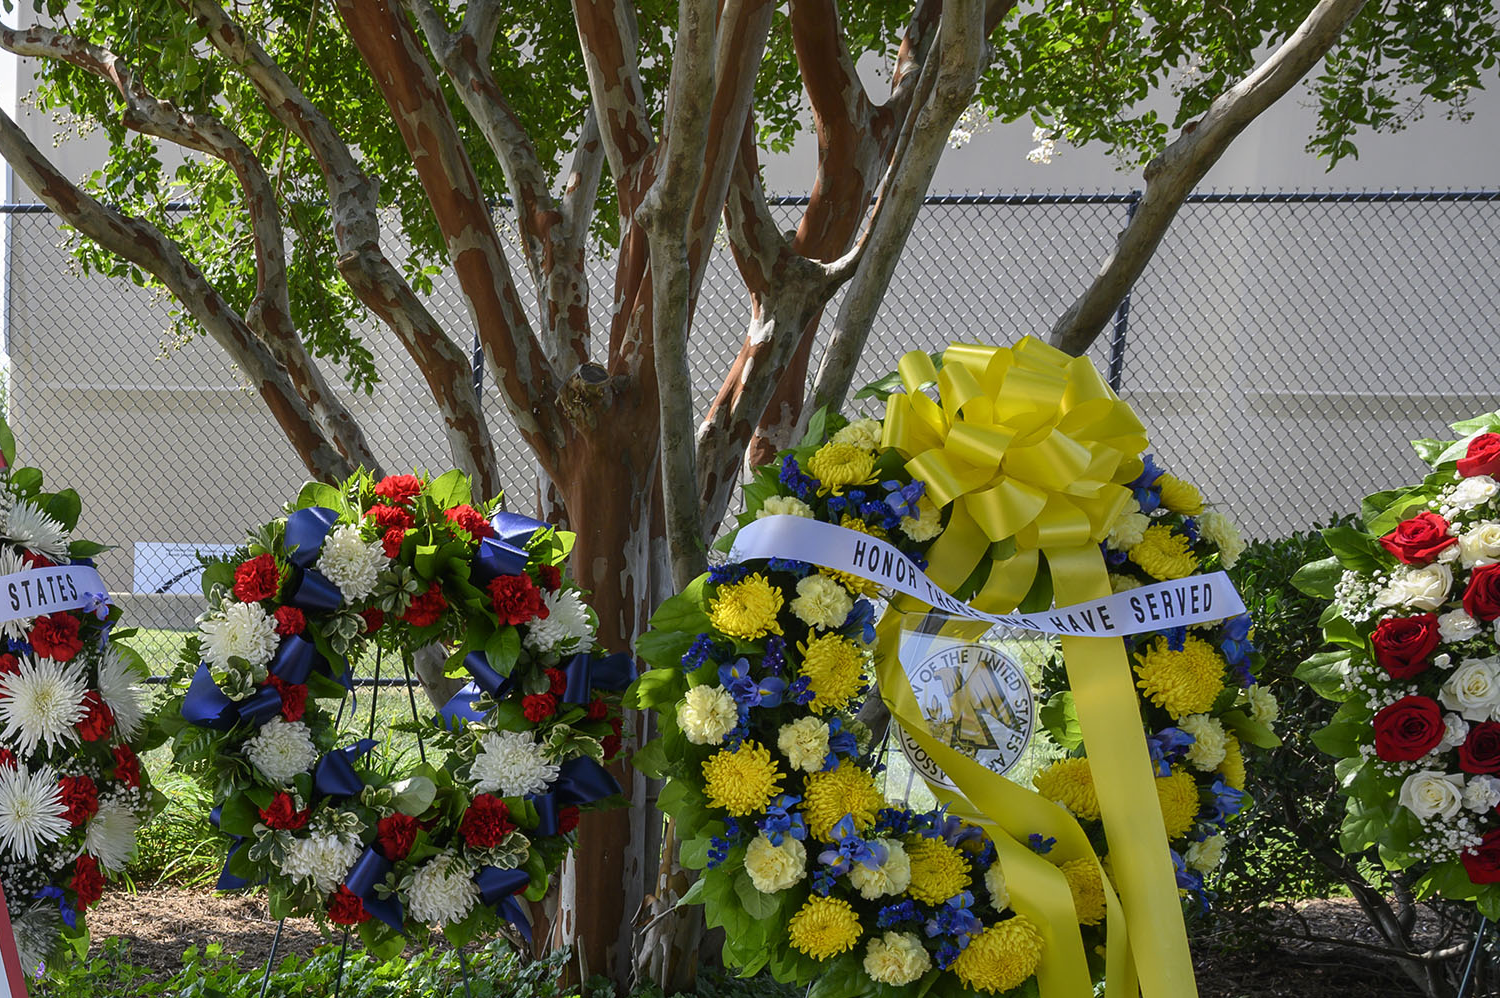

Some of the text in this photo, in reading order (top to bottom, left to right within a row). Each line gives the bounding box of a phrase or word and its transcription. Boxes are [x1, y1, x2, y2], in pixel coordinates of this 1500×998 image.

[8, 573, 78, 612] STATES
[853, 540, 1212, 633] HONOR THOSE WHO HAVE SERVED
[920, 661, 938, 684] OF
[941, 649, 969, 669] THE
[977, 650, 1022, 692] UNITED
[1007, 698, 1029, 754] STATES
